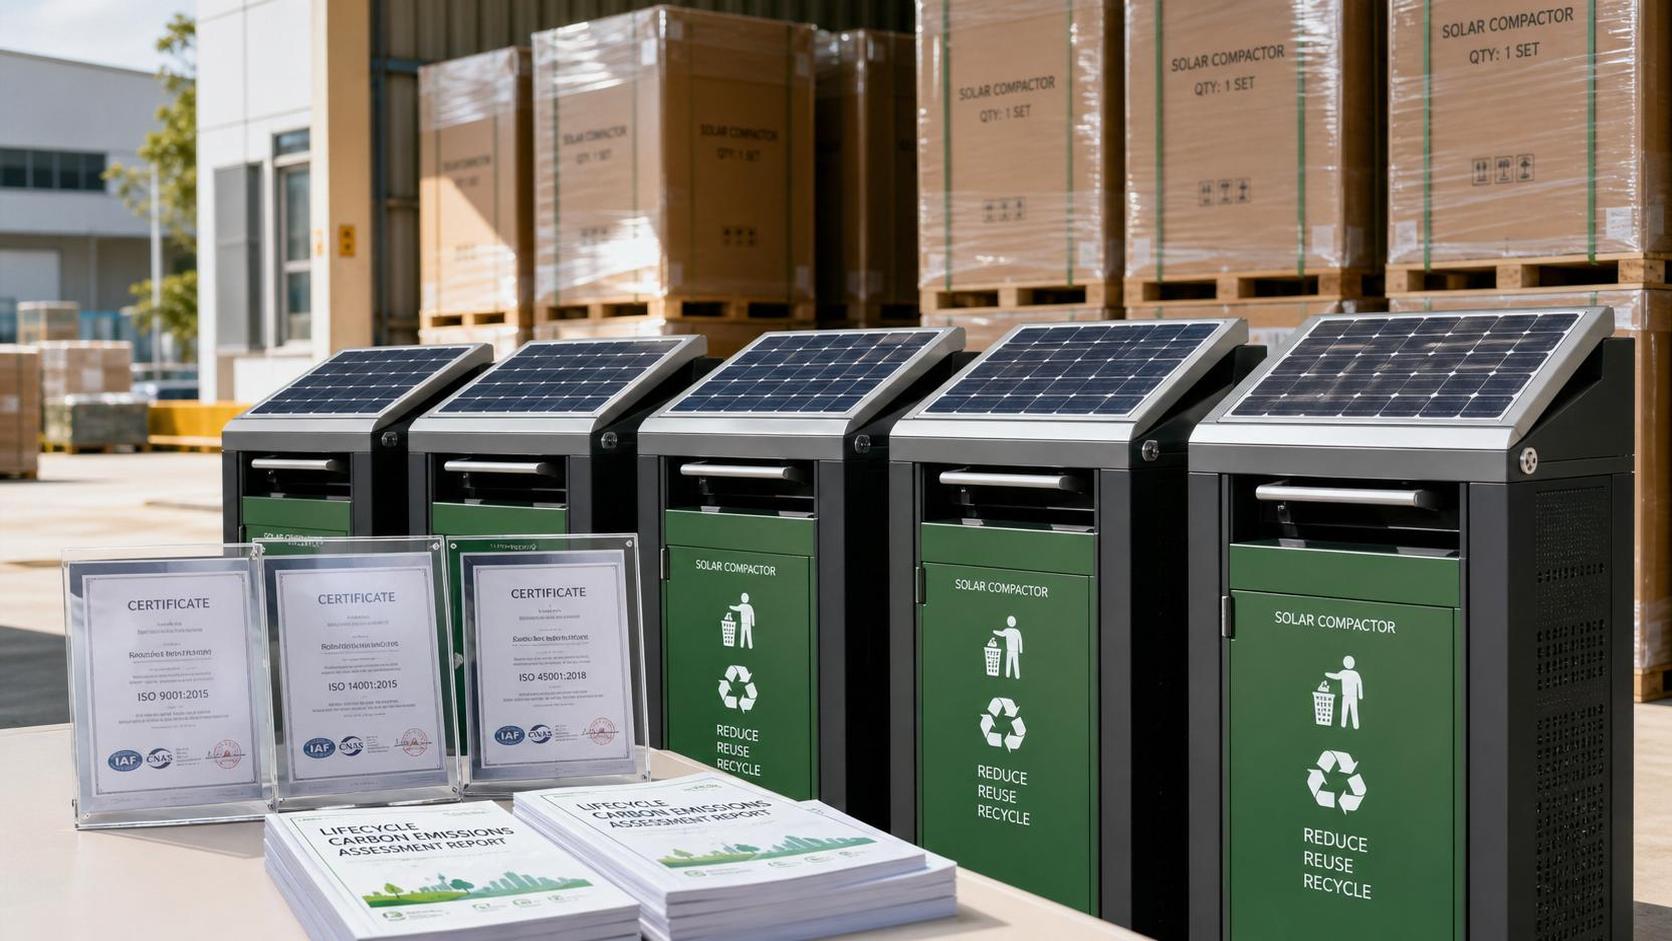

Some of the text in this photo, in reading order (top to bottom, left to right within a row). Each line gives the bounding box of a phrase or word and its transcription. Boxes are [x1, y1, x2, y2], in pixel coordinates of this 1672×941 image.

[1442, 7, 1574, 39] SOLAR COMPACTOR
[1171, 44, 1285, 72] SOLAR COMPACTOR
[1469, 42, 1540, 64] QTY: 1 SET
[959, 75, 1056, 101] SOLAR COMPACTOR
[1194, 76, 1255, 96] QTY: 1 SET
[979, 104, 1031, 123] QTY: 1 SET
[695, 559, 776, 576] SOLAR COMPACTOR
[317, 591, 396, 605] CERTIFICATE
[510, 586, 587, 599] CERTIFICATE
[955, 578, 1048, 598] SOLAR COMPACTOR
[127, 597, 211, 611] CERTIFICATE
[1274, 611, 1396, 634] SOLAR COMPACTOR
[328, 679, 398, 692] ISO 14001:2015
[519, 671, 587, 682] ISO 45001:2018
[137, 689, 209, 702] ISO 9001:2015
[500, 731, 520, 741] IAF
[716, 724, 759, 742] REDUCE
[309, 743, 330, 753] IAF
[716, 741, 750, 758] REUSE
[115, 756, 137, 767] IAF
[146, 753, 173, 764] CNAS
[716, 758, 761, 776] RECYCLE
[977, 764, 1028, 786] REDUCE
[978, 784, 1017, 804] REUSE
[576, 799, 670, 812] LIFECYCLE
[592, 799, 773, 820] CARBON EMISSIONS
[977, 804, 1031, 826] RECYCLE
[609, 808, 773, 829] ASSESSMENT REPORT
[319, 822, 420, 837] LIFECYCLE
[328, 826, 515, 847] CARBON EMISSIONS
[338, 837, 507, 857] ASSESSMENT REPORT
[1303, 827, 1368, 853] REDUCE
[1303, 850, 1353, 874] REUSE
[1303, 873, 1372, 900] RECYCLE
